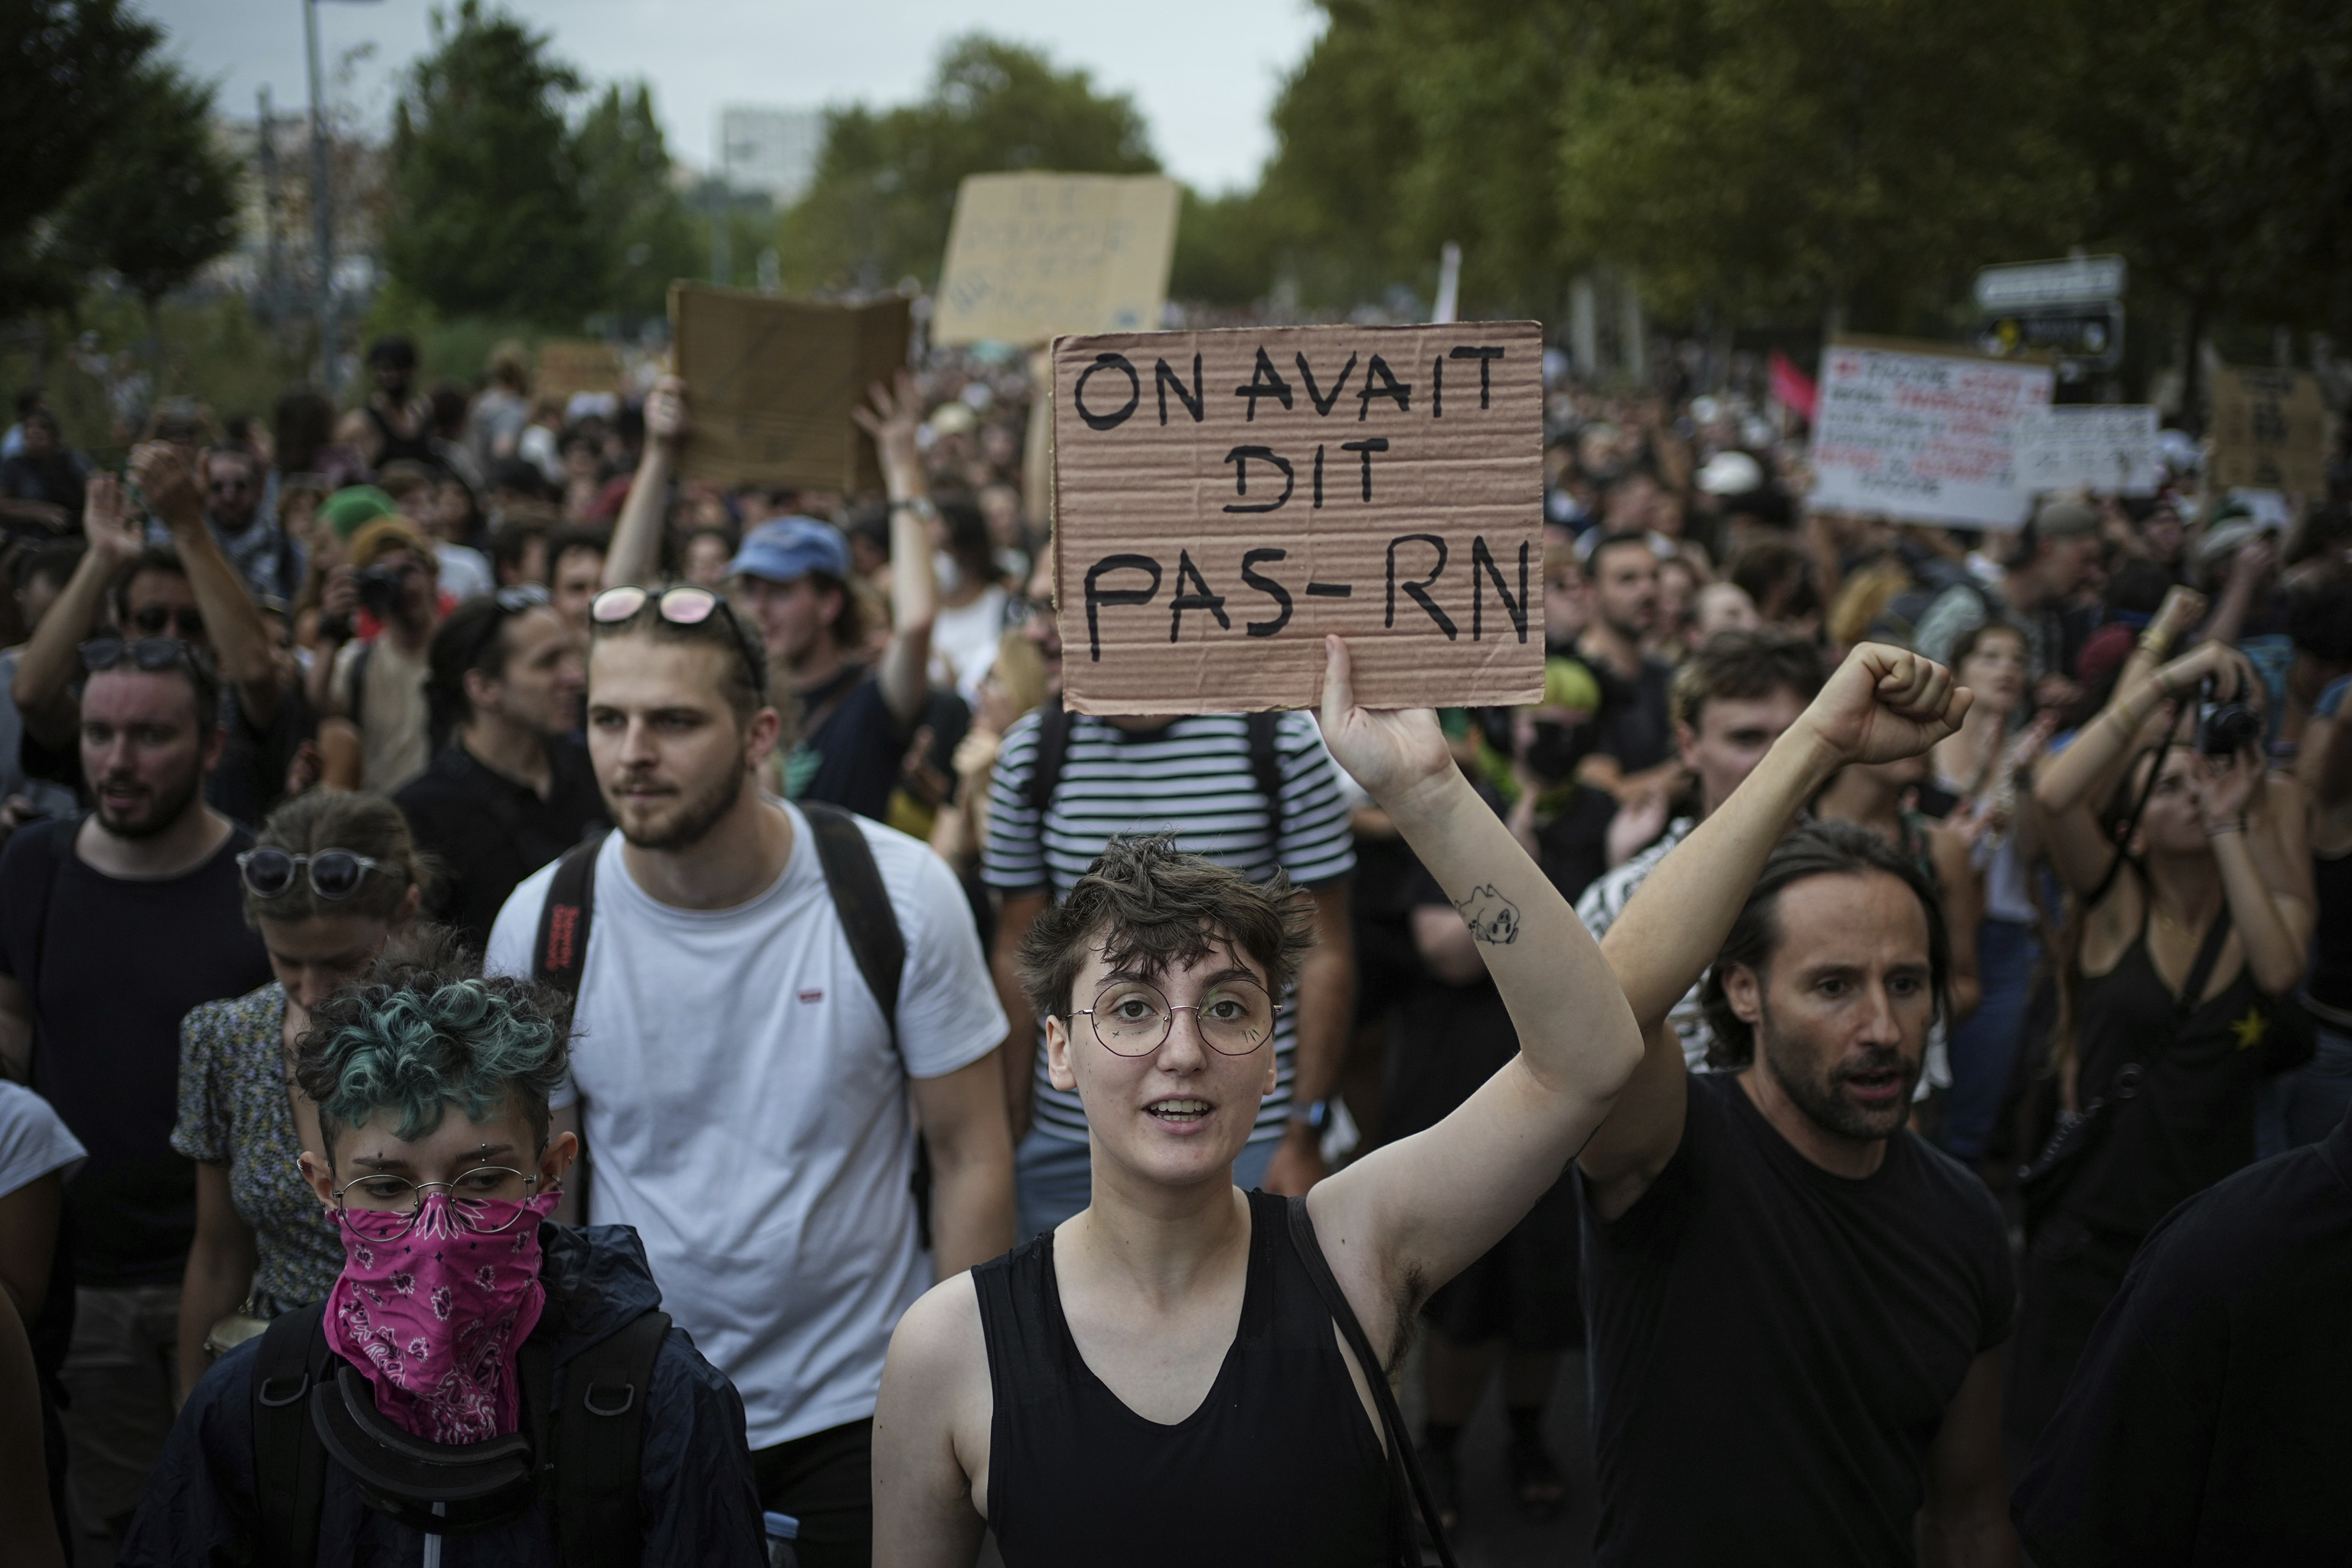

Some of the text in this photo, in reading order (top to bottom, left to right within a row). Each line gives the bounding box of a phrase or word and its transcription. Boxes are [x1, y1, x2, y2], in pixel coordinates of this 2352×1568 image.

[1074, 345, 1505, 430] ON AVAIT
[1222, 438, 1390, 513] DIT
[1084, 534, 1529, 663] PAS-RN
